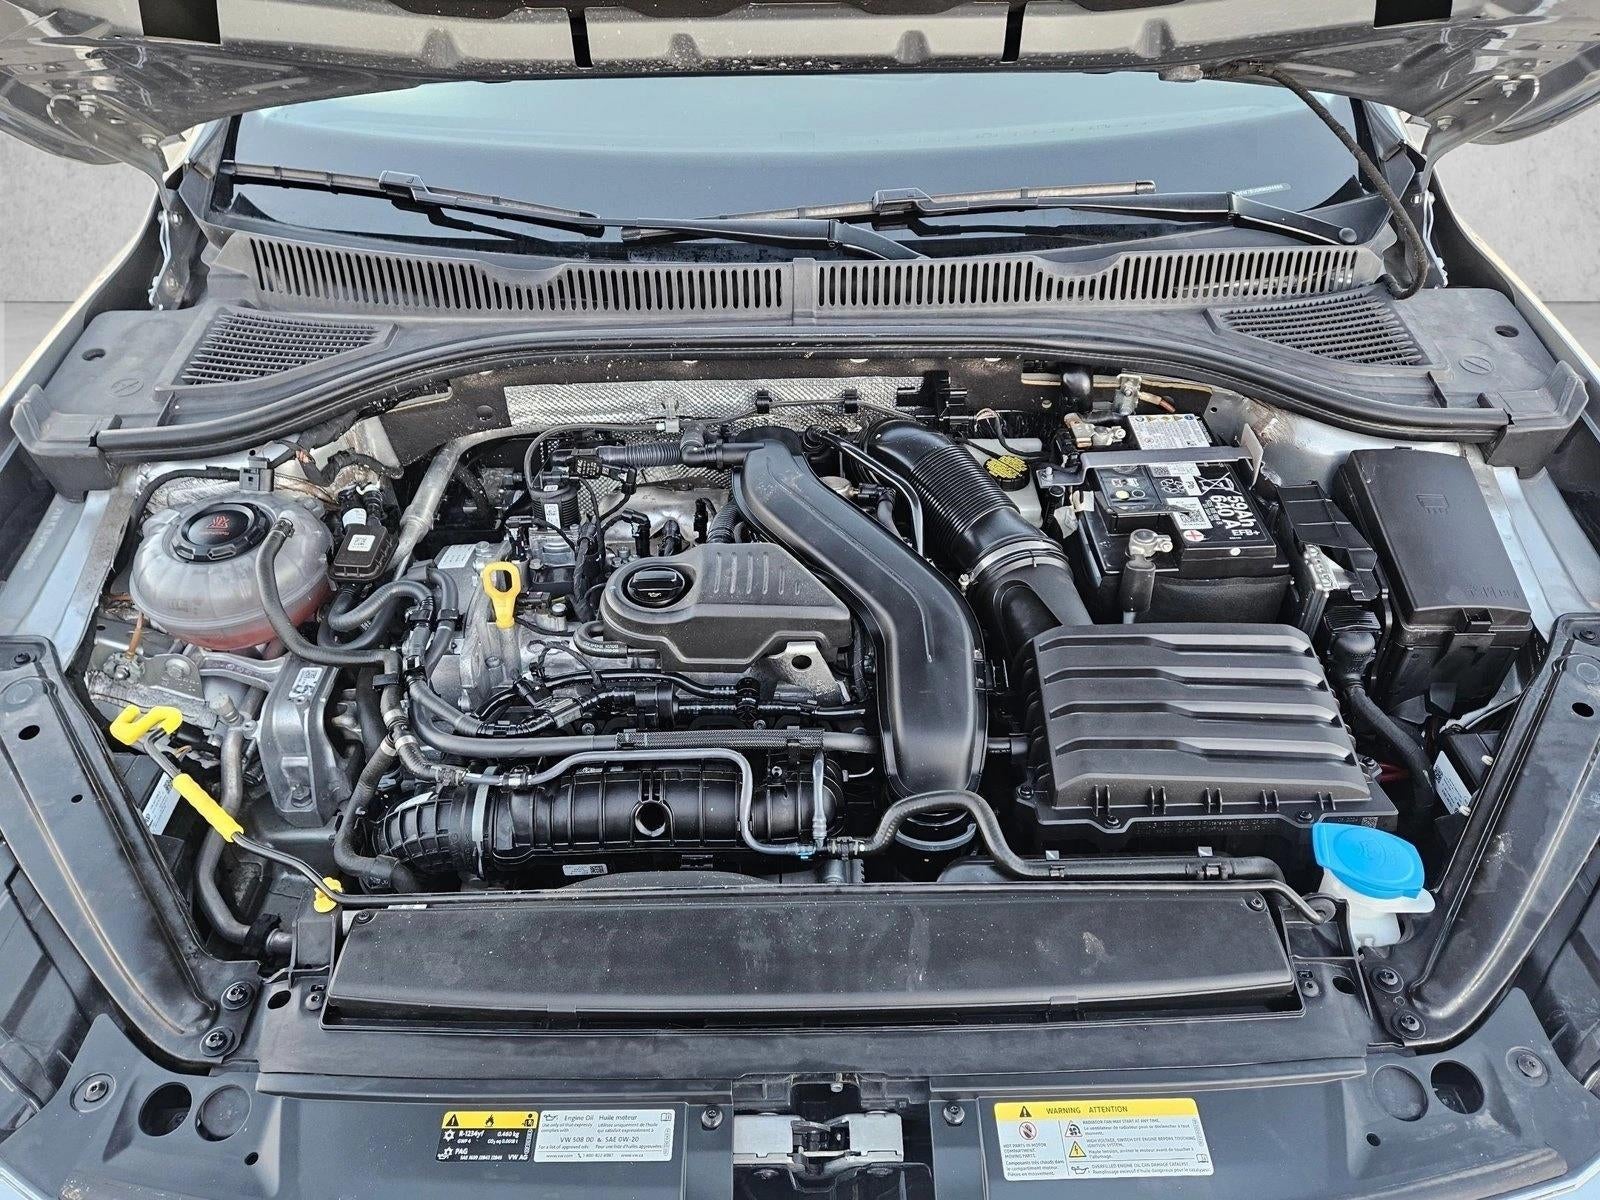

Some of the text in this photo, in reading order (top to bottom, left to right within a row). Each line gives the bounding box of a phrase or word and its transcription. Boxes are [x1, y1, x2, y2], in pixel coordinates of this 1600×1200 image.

[1210, 495, 1235, 517] 640
[1222, 519, 1241, 529] A
[1231, 529, 1260, 537] EFB+
[458, 1130, 485, 1138] R-1234yf
